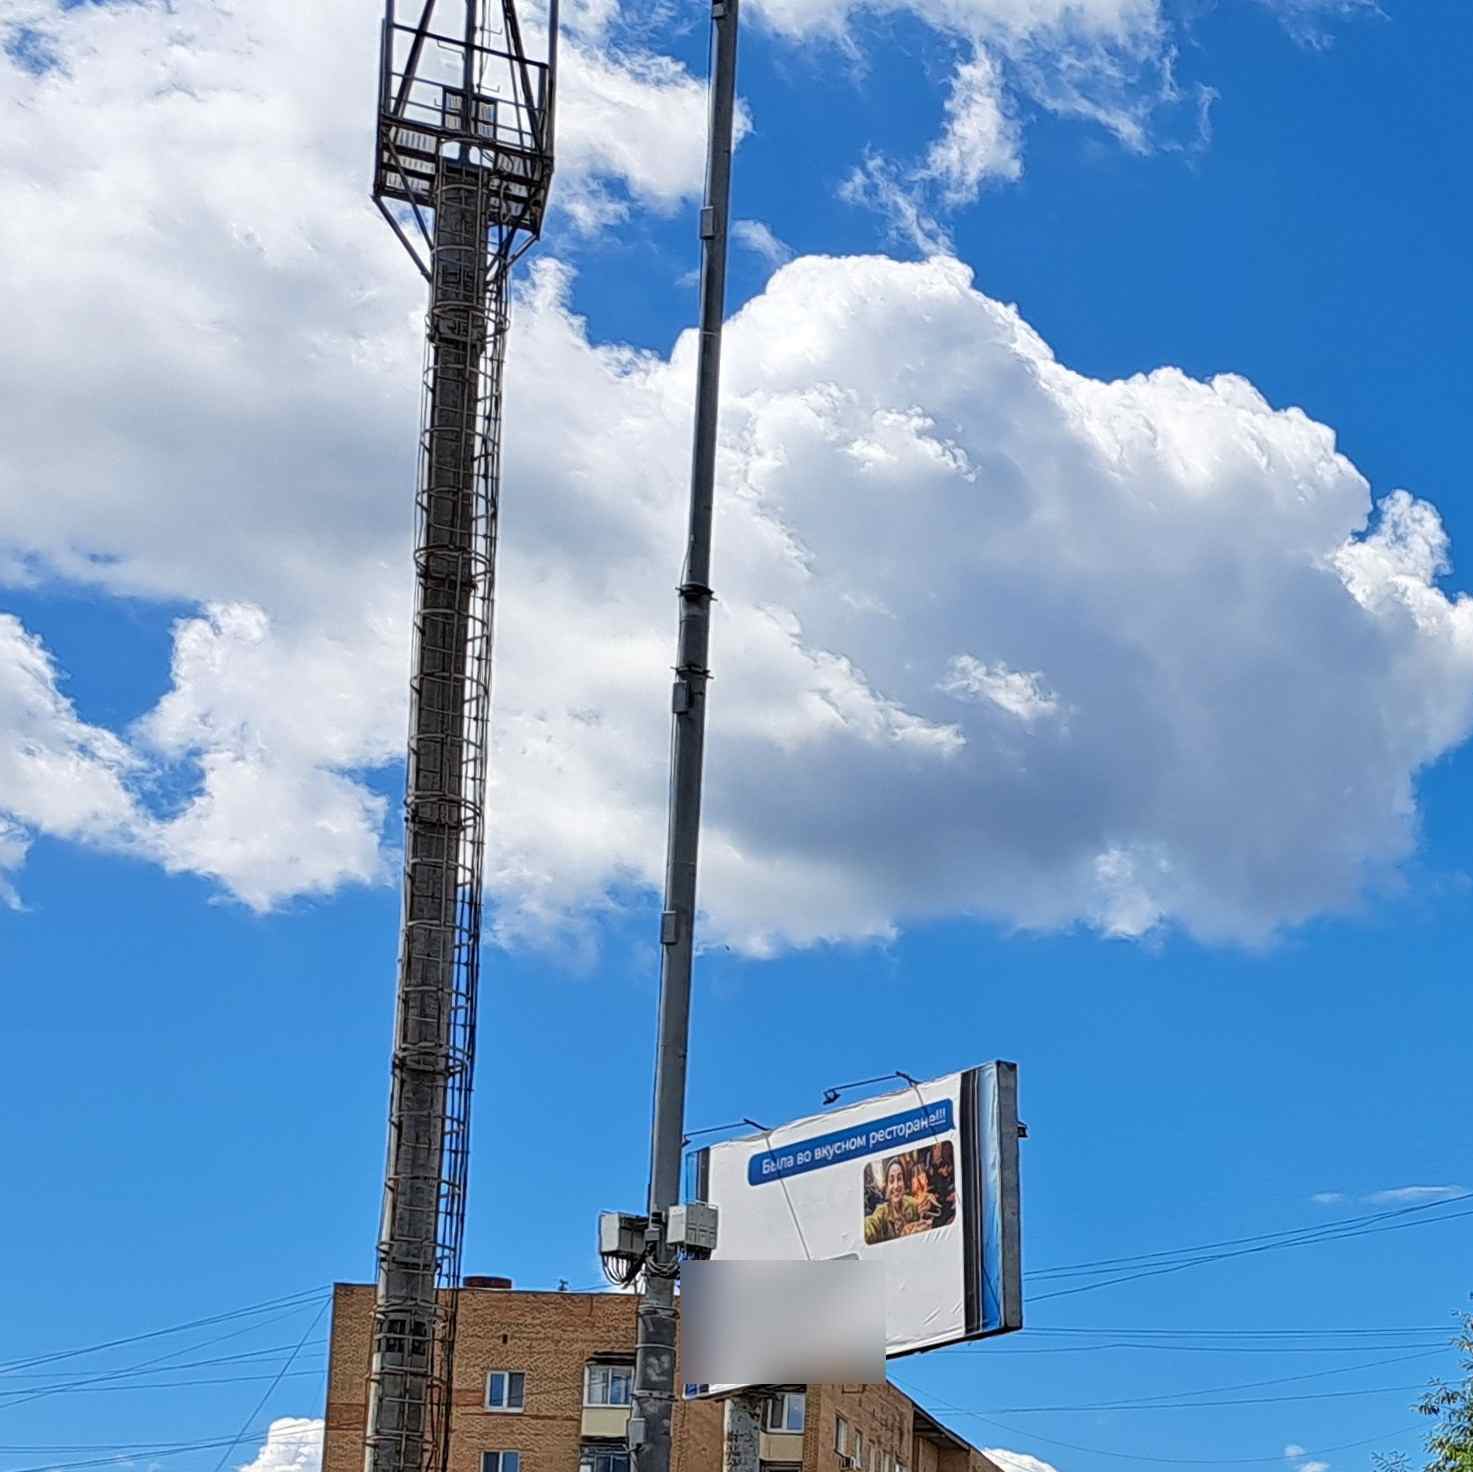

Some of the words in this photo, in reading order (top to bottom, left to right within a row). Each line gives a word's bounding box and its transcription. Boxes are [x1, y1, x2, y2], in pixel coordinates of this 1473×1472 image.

[762, 1154, 794, 1175] Была
[796, 1150, 812, 1163] во
[815, 1135, 867, 1160] вкусном
